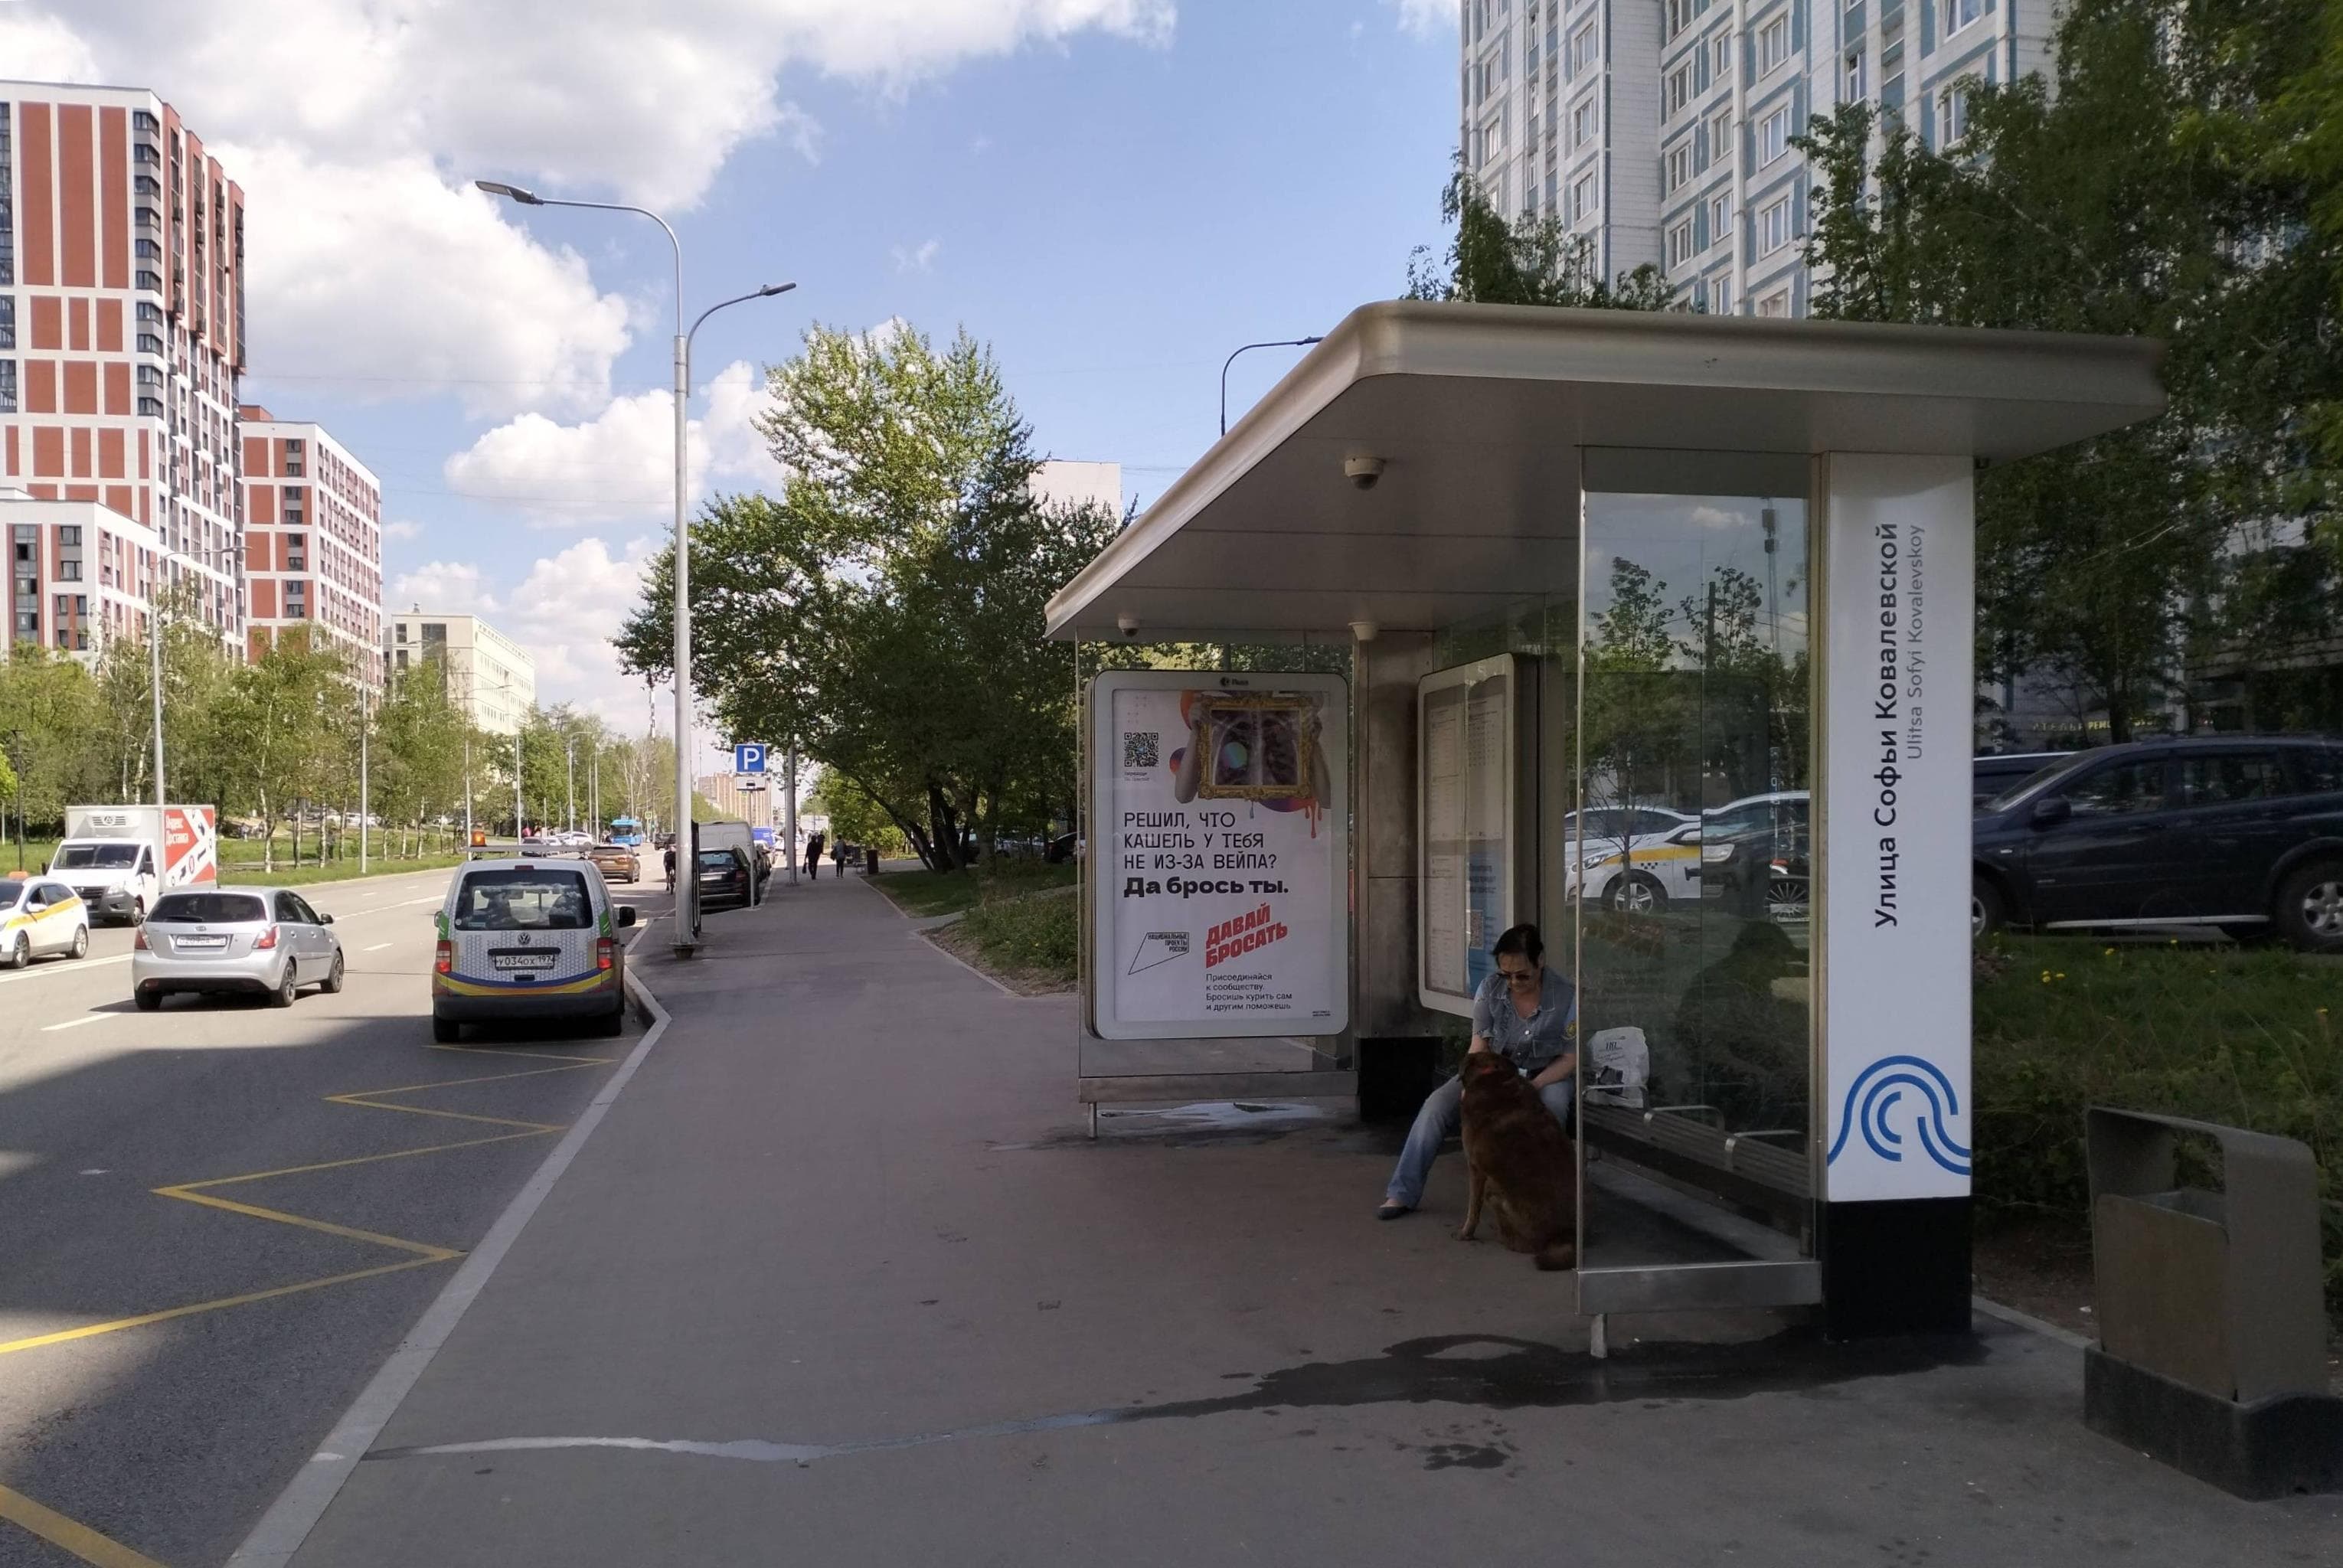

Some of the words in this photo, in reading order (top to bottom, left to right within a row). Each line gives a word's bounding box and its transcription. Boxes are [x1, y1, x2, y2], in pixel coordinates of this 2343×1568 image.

[1907, 524, 1926, 644] Kovalevskoy
[1874, 522, 1897, 720] Ковалевской
[1907, 649, 1926, 699] Sofyi
[1907, 705, 1923, 760] Ulitsa
[743, 747, 760, 770] P
[1874, 730, 1901, 827] Софьи
[1124, 812, 1190, 829] РЕШИЛ,
[1199, 812, 1236, 828] ЧТО
[1124, 833, 1195, 848] КАШЕЛЬ
[1204, 833, 1214, 848] У
[1124, 854, 1145, 869] НЕ
[1154, 854, 1204, 870] ИЗ-ЗА
[1213, 851, 1277, 870] ВЕЙПА?
[1123, 877, 1162, 898] Да
[1166, 877, 1244, 899] брось
[1248, 880, 1289, 893] ты.
[1874, 836, 1900, 928] Улица
[1206, 902, 1271, 949] ДАВАЙ
[1206, 922, 1288, 969] БРОСАТЬ
[1206, 972, 1273, 982] Присоединяйся
[1206, 993, 1243, 1001] Бросишь
[1213, 1004, 1243, 1012] другим
